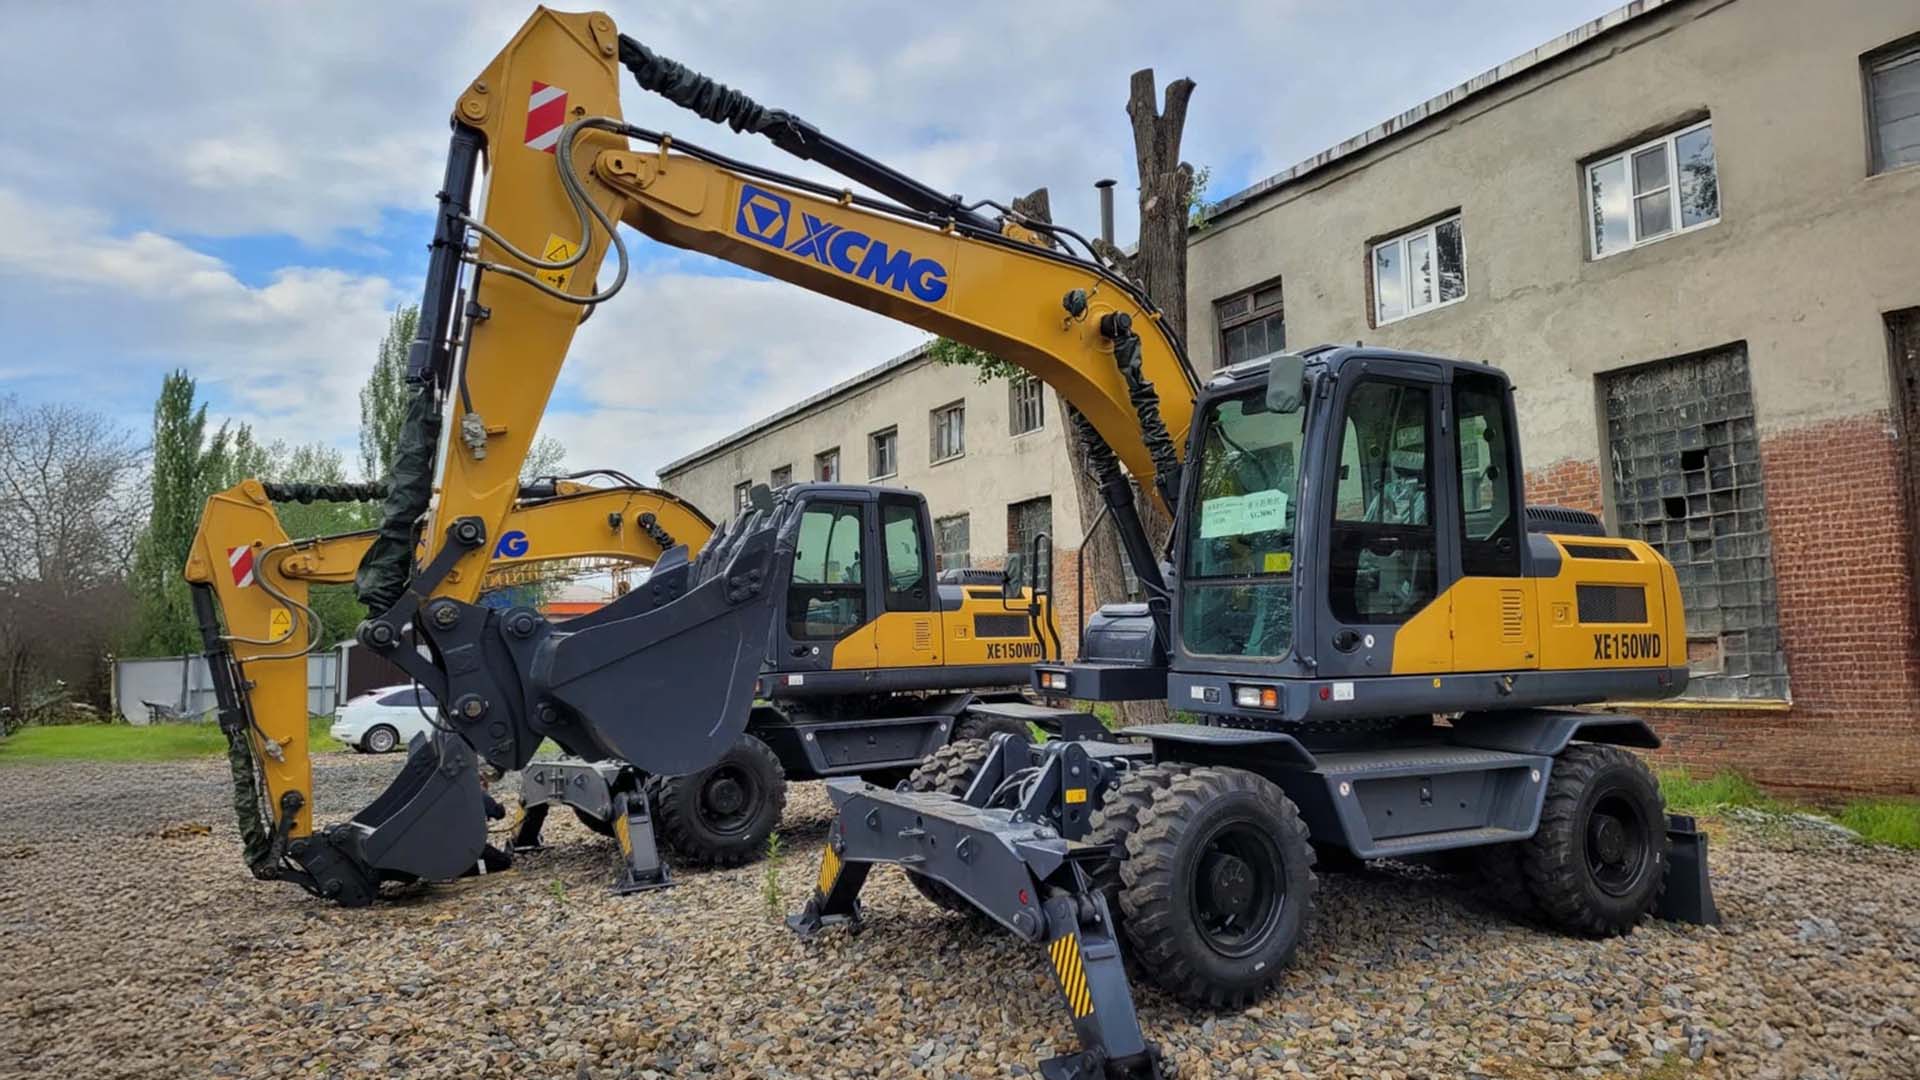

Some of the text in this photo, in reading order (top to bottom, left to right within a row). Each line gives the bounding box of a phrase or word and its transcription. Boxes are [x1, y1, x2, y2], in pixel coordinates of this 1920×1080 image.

[784, 211, 948, 303] XCMG
[986, 642, 1041, 660] XE150WD
[1593, 633, 1661, 660] XE150WD
